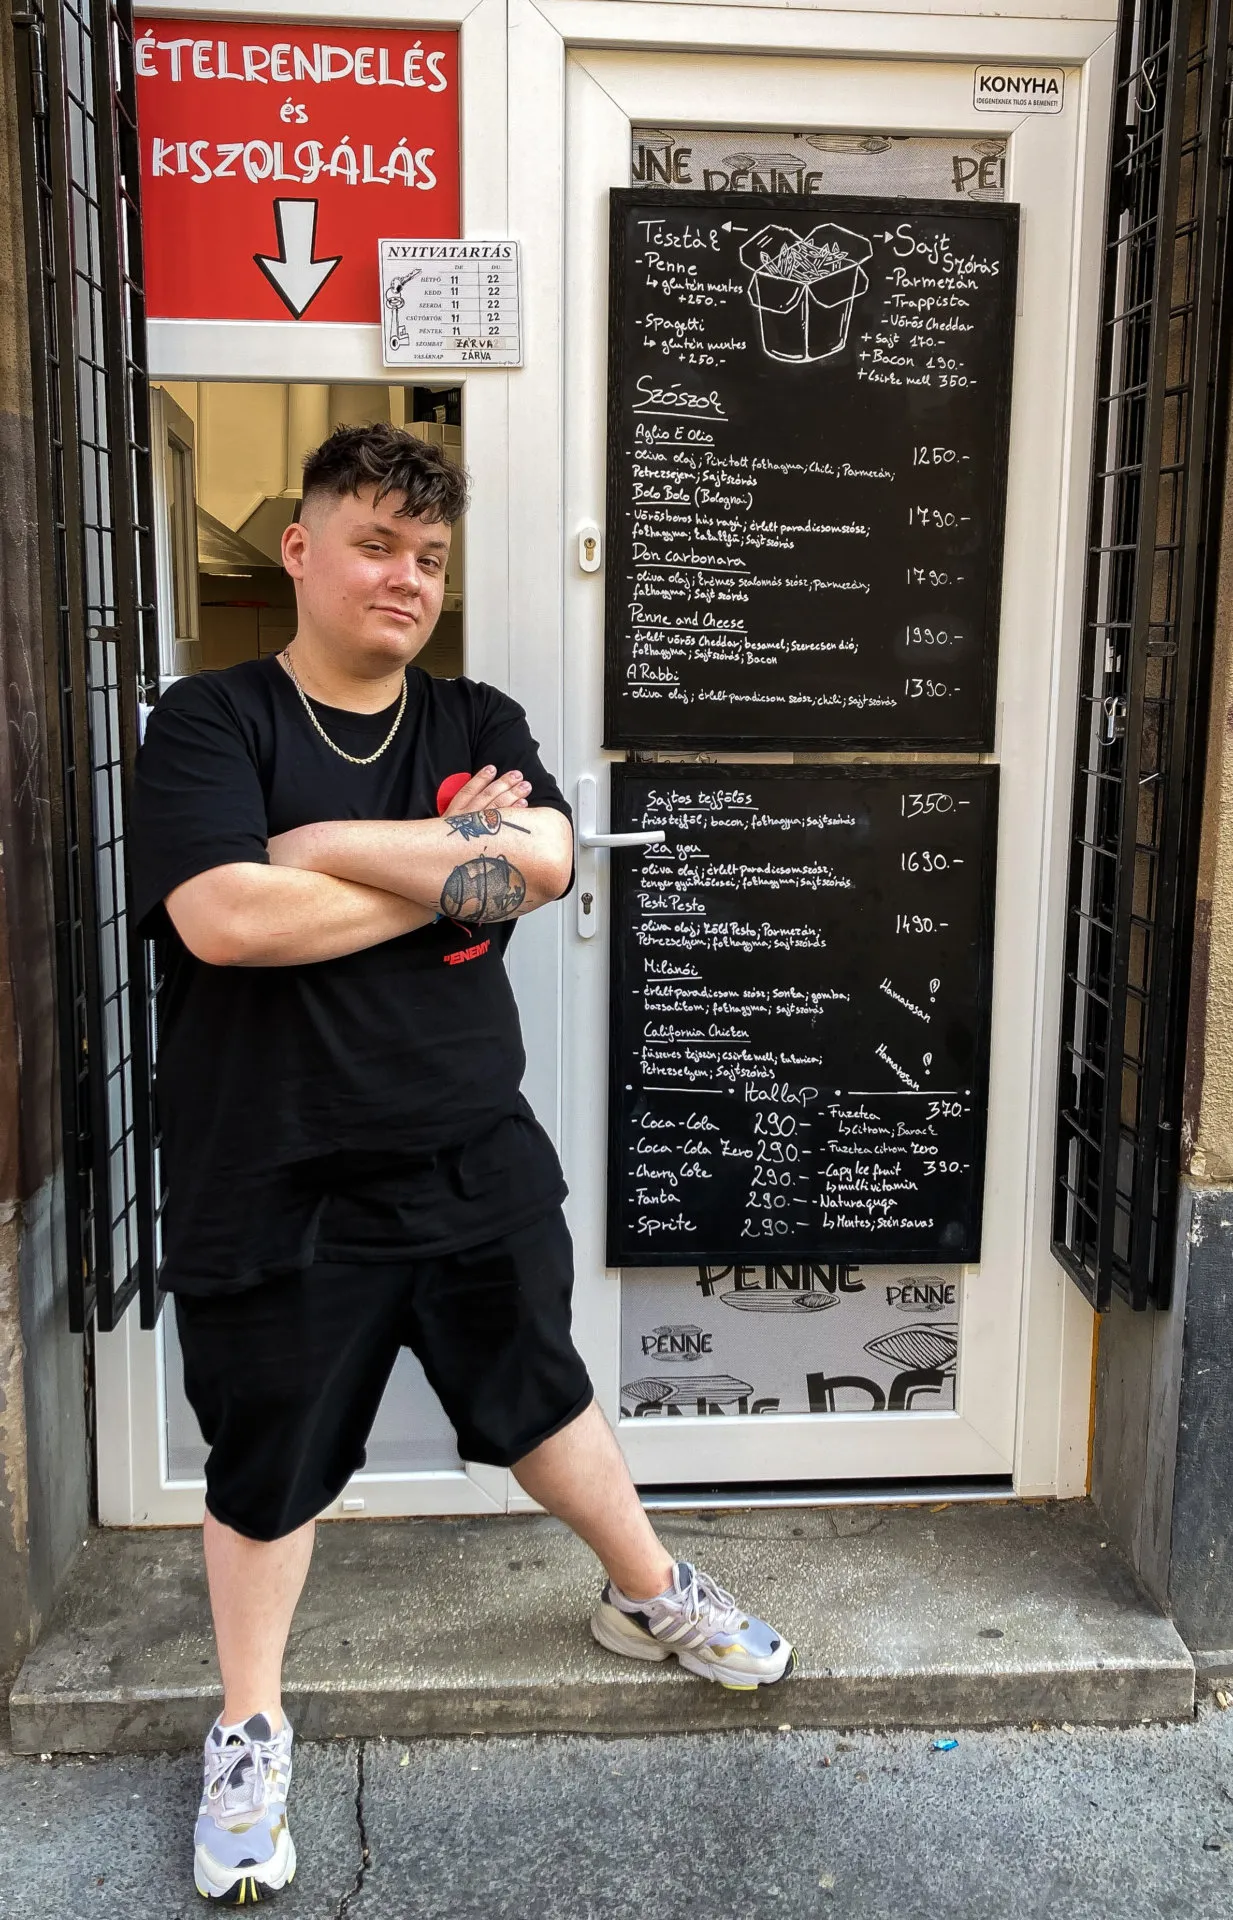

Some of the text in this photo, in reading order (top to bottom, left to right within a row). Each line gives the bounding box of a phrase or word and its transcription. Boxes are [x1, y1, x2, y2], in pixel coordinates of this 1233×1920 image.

[135, 29, 448, 93] ÉTELRENDELÉS
[980, 76, 1058, 94] KONYHA
[279, 97, 309, 124] és
[152, 134, 437, 190] KISZOLGÁLÁS
[388, 244, 512, 258] NYITVATARTÁS
[893, 224, 950, 264] Sajt
[942, 252, 1000, 276] Szórás
[451, 276, 458, 284] 11
[487, 275, 499, 283] 22
[451, 287, 458, 295] 11
[488, 287, 500, 296] 22
[452, 300, 459, 309] 11
[488, 300, 500, 309] 22
[452, 314, 459, 322] 11
[488, 313, 500, 322] 22
[926, 317, 974, 331] Cheddar
[452, 327, 460, 335] 11
[489, 326, 500, 335] 22
[456, 338, 493, 348] ZÁRVA
[876, 333, 900, 348] Sajt
[462, 351, 491, 361] ZÁRVA
[872, 349, 914, 366] Bacon
[906, 375, 931, 386] mell
[636, 423, 669, 444] Aglio
[688, 429, 713, 442] Olio
[632, 483, 660, 500] Bolo
[663, 485, 690, 501] Bolo
[632, 543, 661, 561] Don
[628, 603, 744, 629] Penne and Cheese
[748, 652, 778, 664] Bacon
[627, 663, 679, 681] A Rabbi
[646, 790, 692, 810] Sajtos
[901, 792, 971, 818] 1350.-
[676, 845, 701, 861] you
[637, 893, 705, 912] Pesti Pesto
[644, 1021, 705, 1042] California
[754, 1112, 811, 1137] 290.-
[720, 1138, 811, 1162] Zero 290.-
[636, 1162, 809, 1186] Cherry Coke 290.-
[873, 1161, 902, 1178] fruit
[636, 1188, 807, 1209] Fanta 290.-
[638, 1212, 810, 1237] Sprite 290.-
[696, 1264, 866, 1297] PENNE
[886, 1284, 955, 1305] PENNE
[641, 1333, 713, 1356] PENNE
